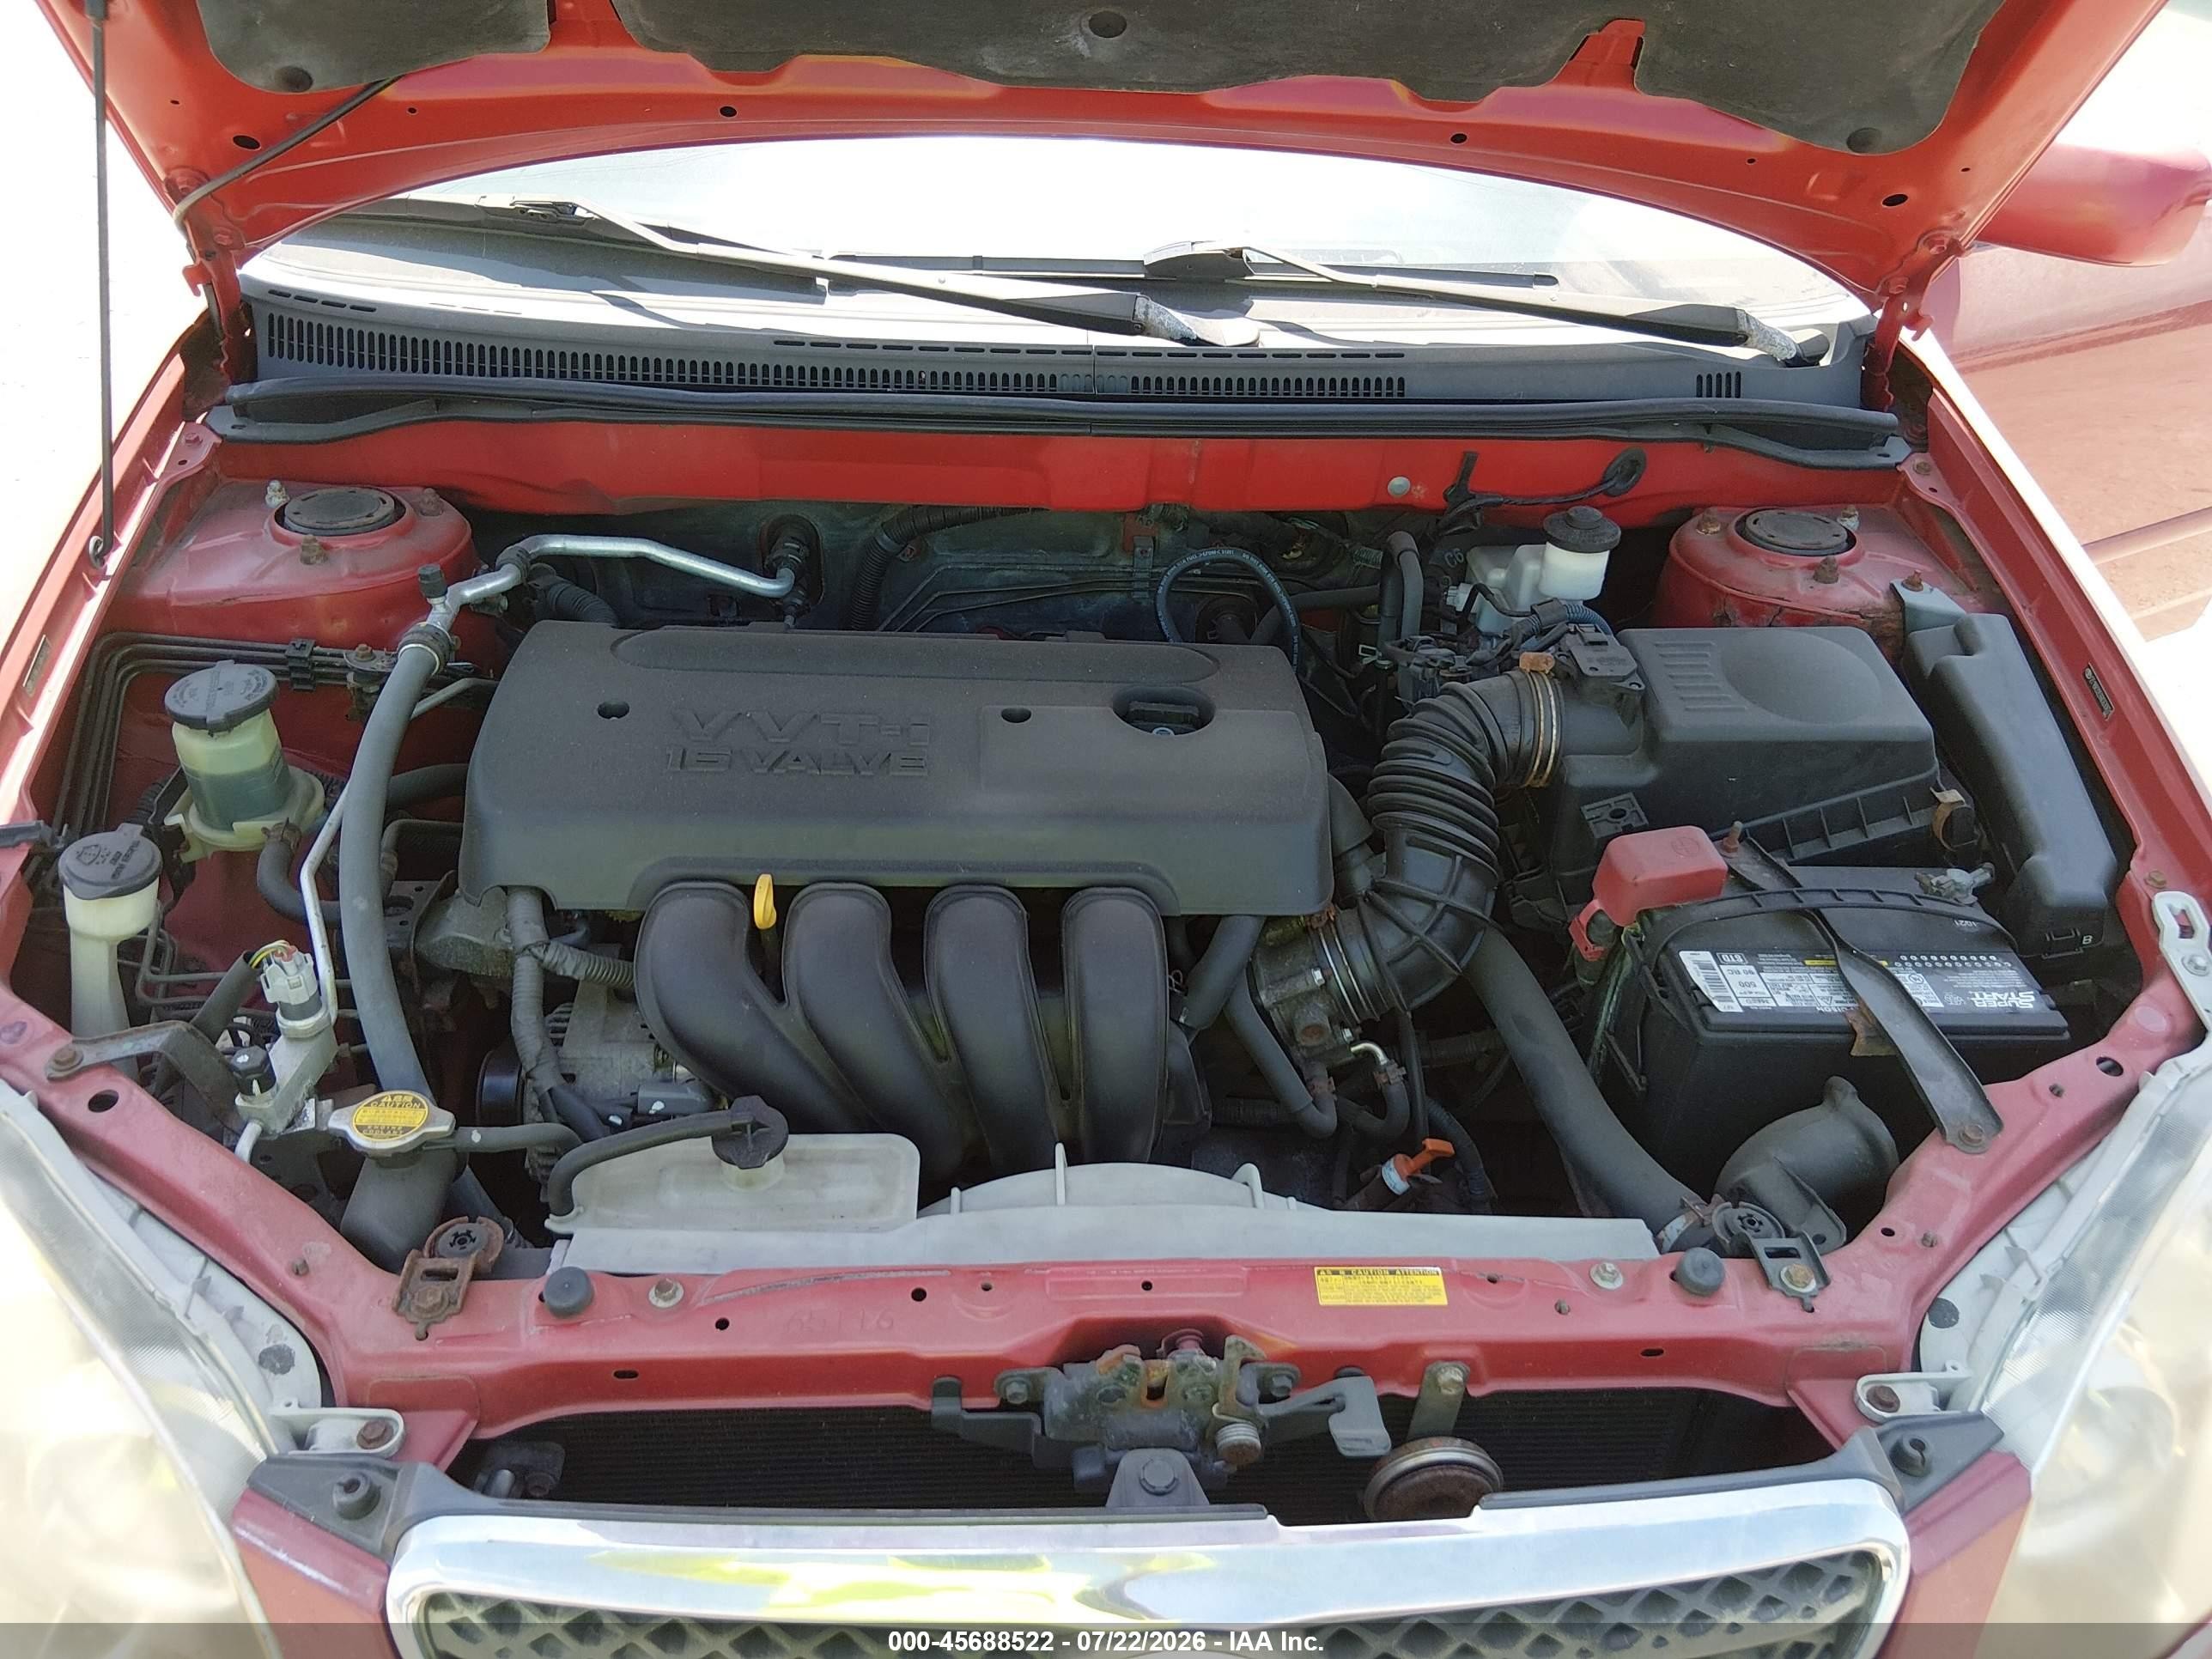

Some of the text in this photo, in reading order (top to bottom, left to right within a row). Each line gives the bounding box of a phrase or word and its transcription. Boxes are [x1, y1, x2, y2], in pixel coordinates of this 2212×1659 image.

[665, 747, 929, 776] 16 VALVE
[2081, 934, 2094, 945] B
[1968, 990, 2036, 1002] START
[1973, 999, 2035, 1009] SUPER
